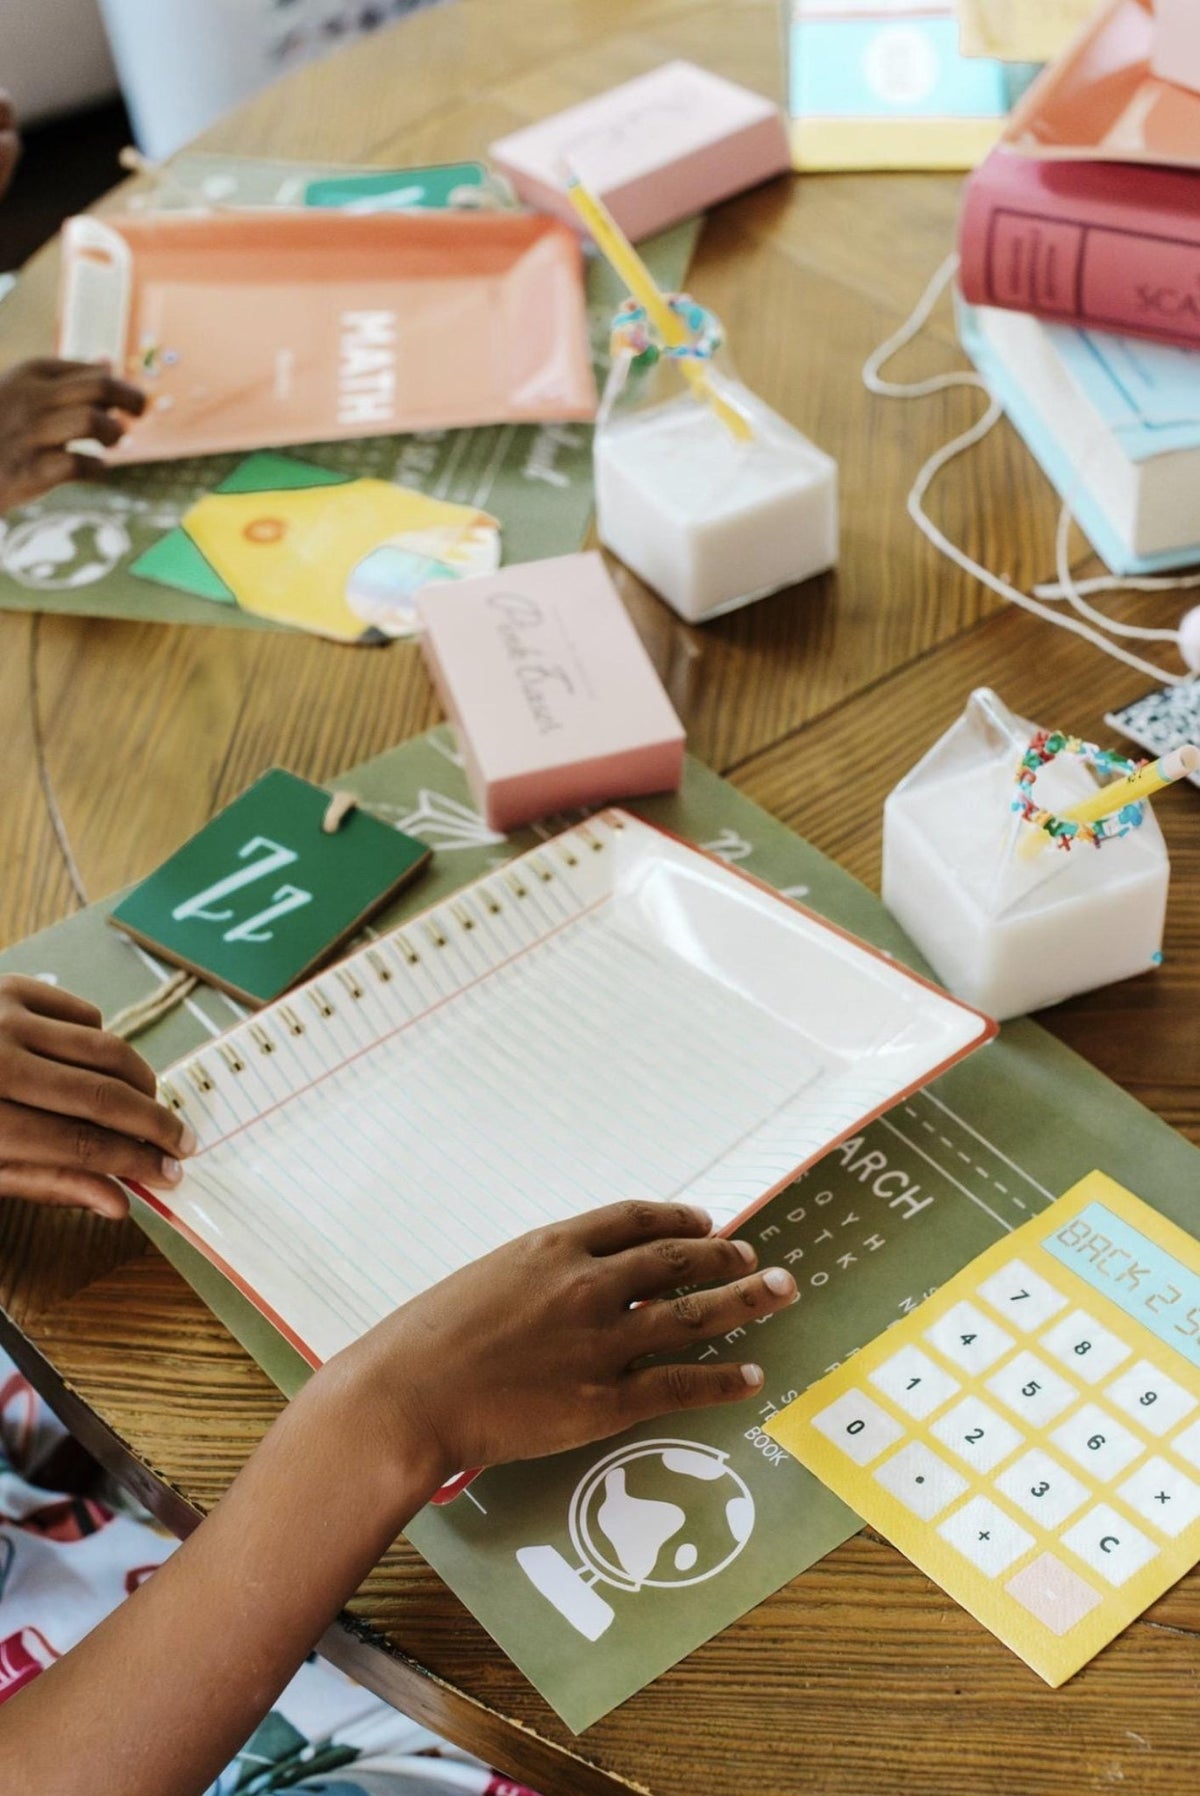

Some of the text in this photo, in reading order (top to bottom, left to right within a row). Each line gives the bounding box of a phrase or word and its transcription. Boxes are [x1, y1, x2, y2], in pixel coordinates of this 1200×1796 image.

[338, 311, 396, 424] MATH
[760, 1224, 829, 1287] E R O
[814, 1228, 834, 1244] T
[836, 1252, 858, 1269] K
[841, 1212, 860, 1226] Y
[863, 1233, 886, 1251] H
[1057, 1220, 1151, 1292] BACK
[1145, 1285, 1182, 1314] 2
[698, 1345, 718, 1360] T
[1010, 1289, 1158, 1406] 7 8 9
[960, 1331, 977, 1346] 4
[1022, 1381, 1041, 1397] 5
[1087, 1435, 1106, 1450] 6
[744, 1425, 789, 1467] BOOK
[846, 1419, 866, 1435] 0
[906, 1377, 1120, 1553] 1 2 3 C
